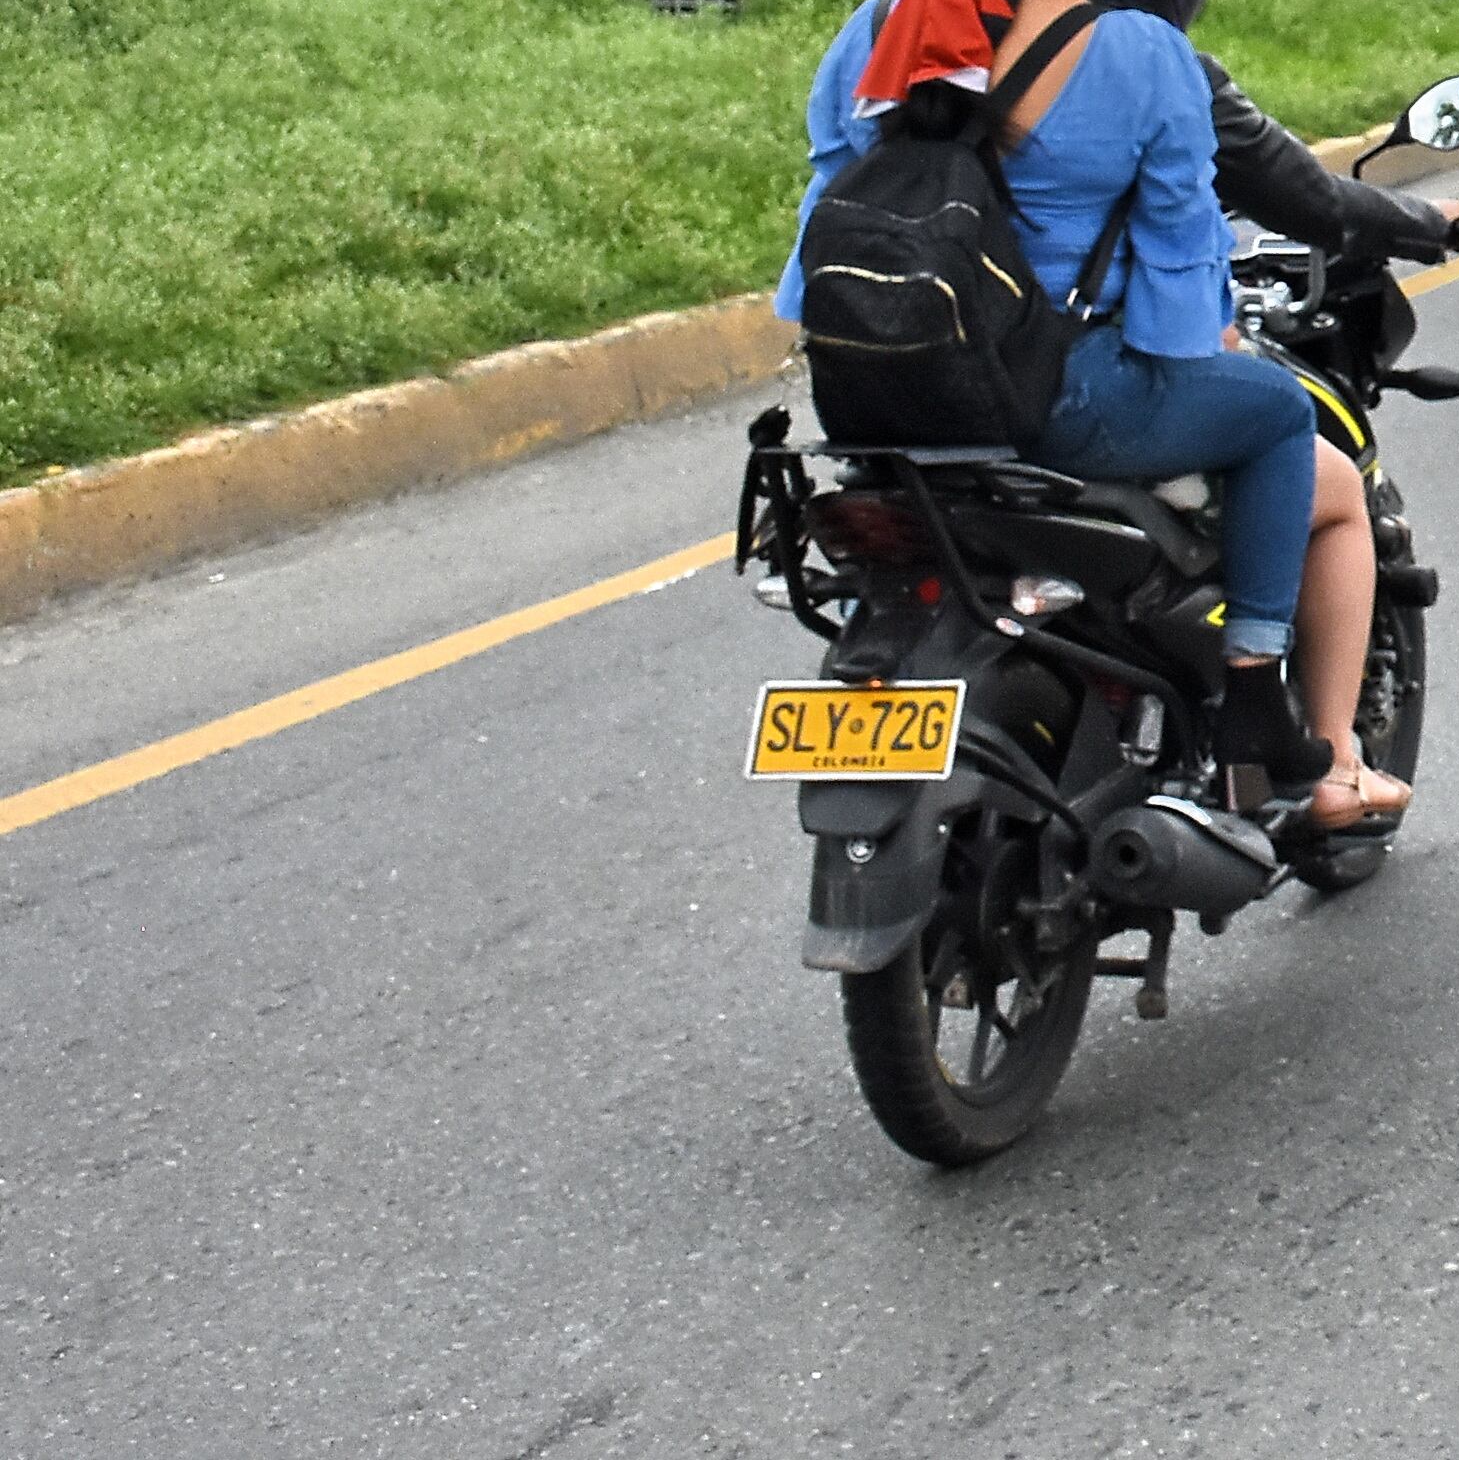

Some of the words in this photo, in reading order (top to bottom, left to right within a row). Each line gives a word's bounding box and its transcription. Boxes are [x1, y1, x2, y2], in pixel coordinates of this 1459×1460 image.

[766, 701, 850, 753] SLY
[870, 700, 947, 752] 72G
[812, 755, 886, 768] COLOMBIA
